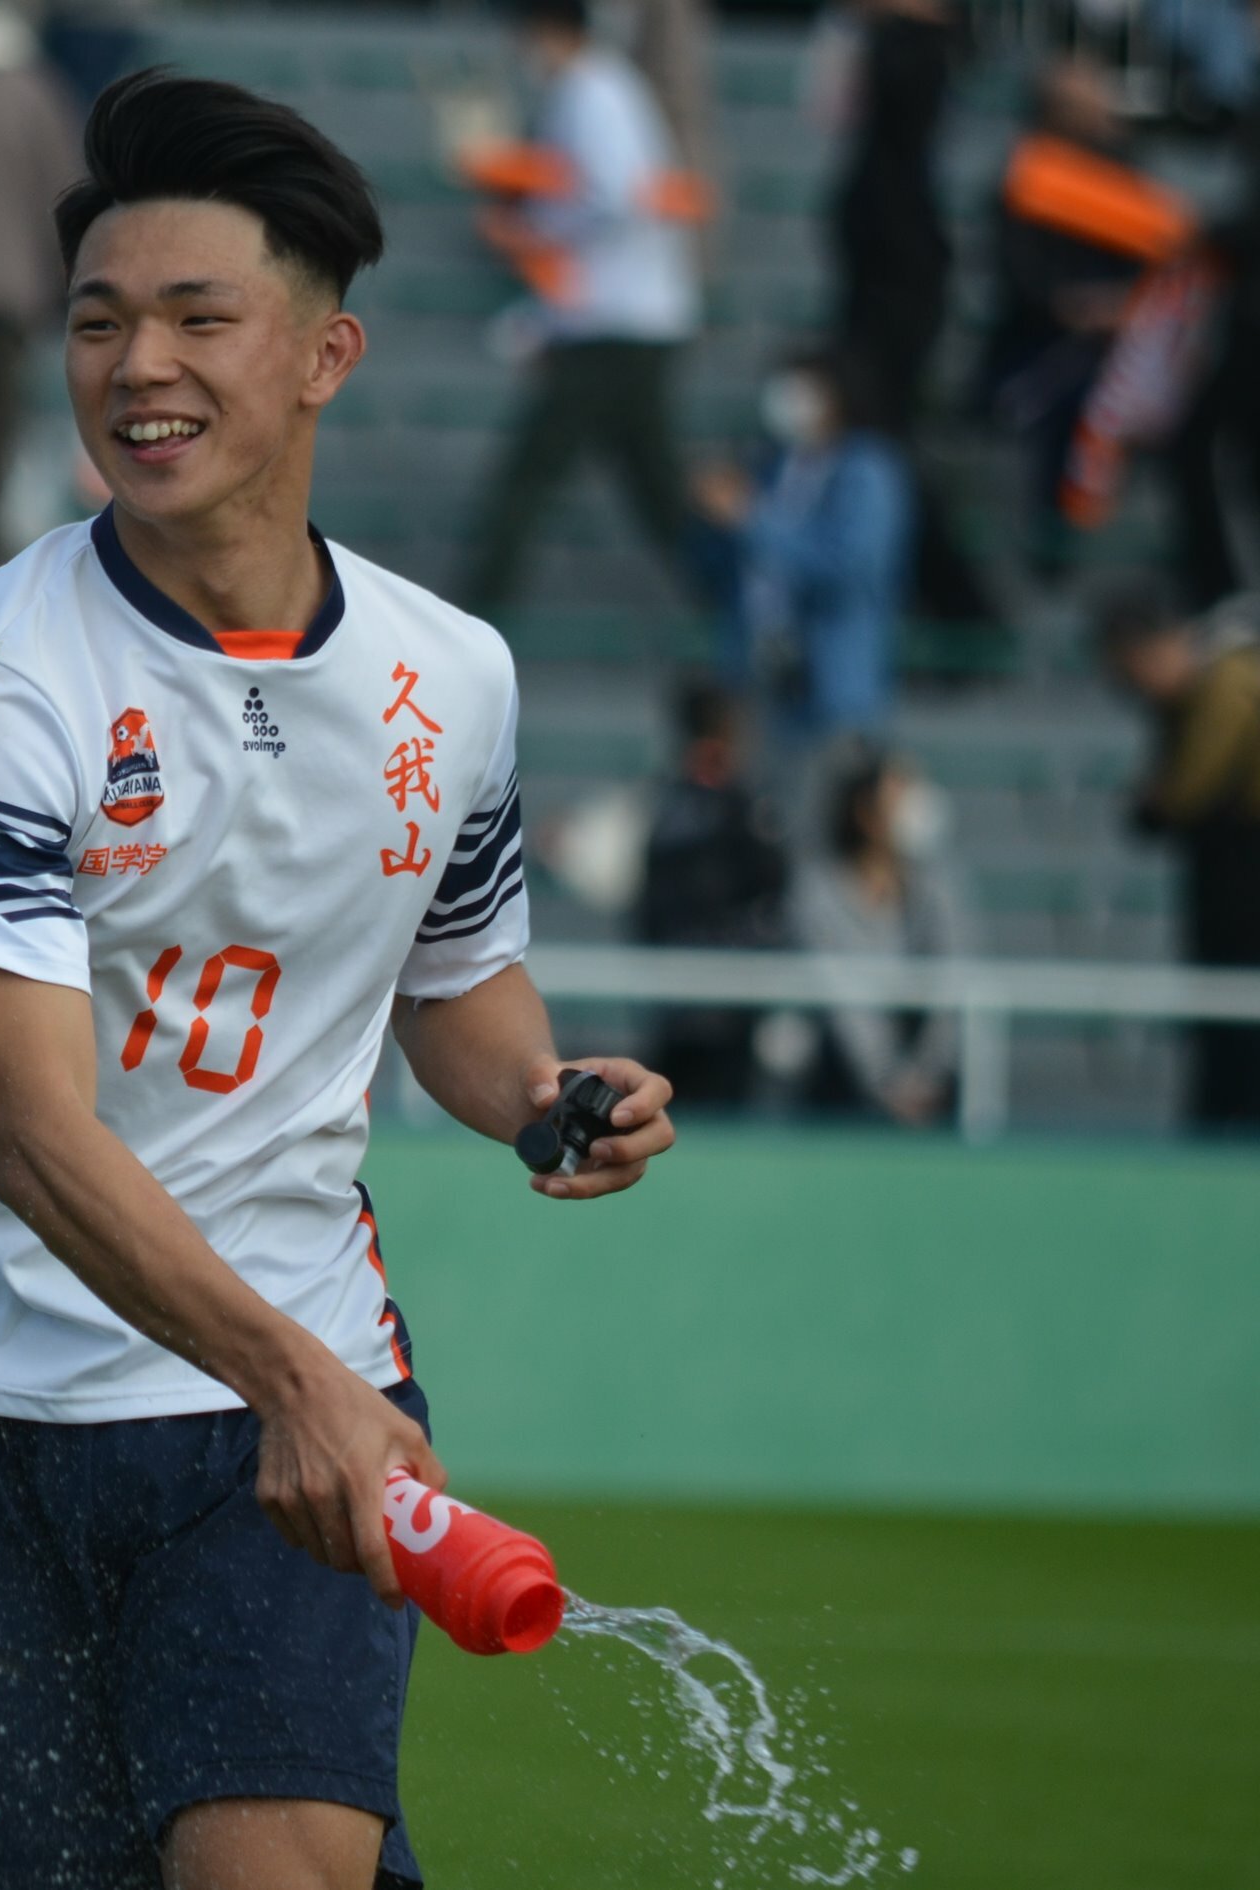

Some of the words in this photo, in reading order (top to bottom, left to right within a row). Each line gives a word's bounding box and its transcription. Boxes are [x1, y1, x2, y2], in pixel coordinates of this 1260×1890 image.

[243, 738, 286, 752] svolme
[380, 661, 443, 877] 久我山
[120, 944, 282, 1095] 10
[383, 1468, 478, 1554] AS
